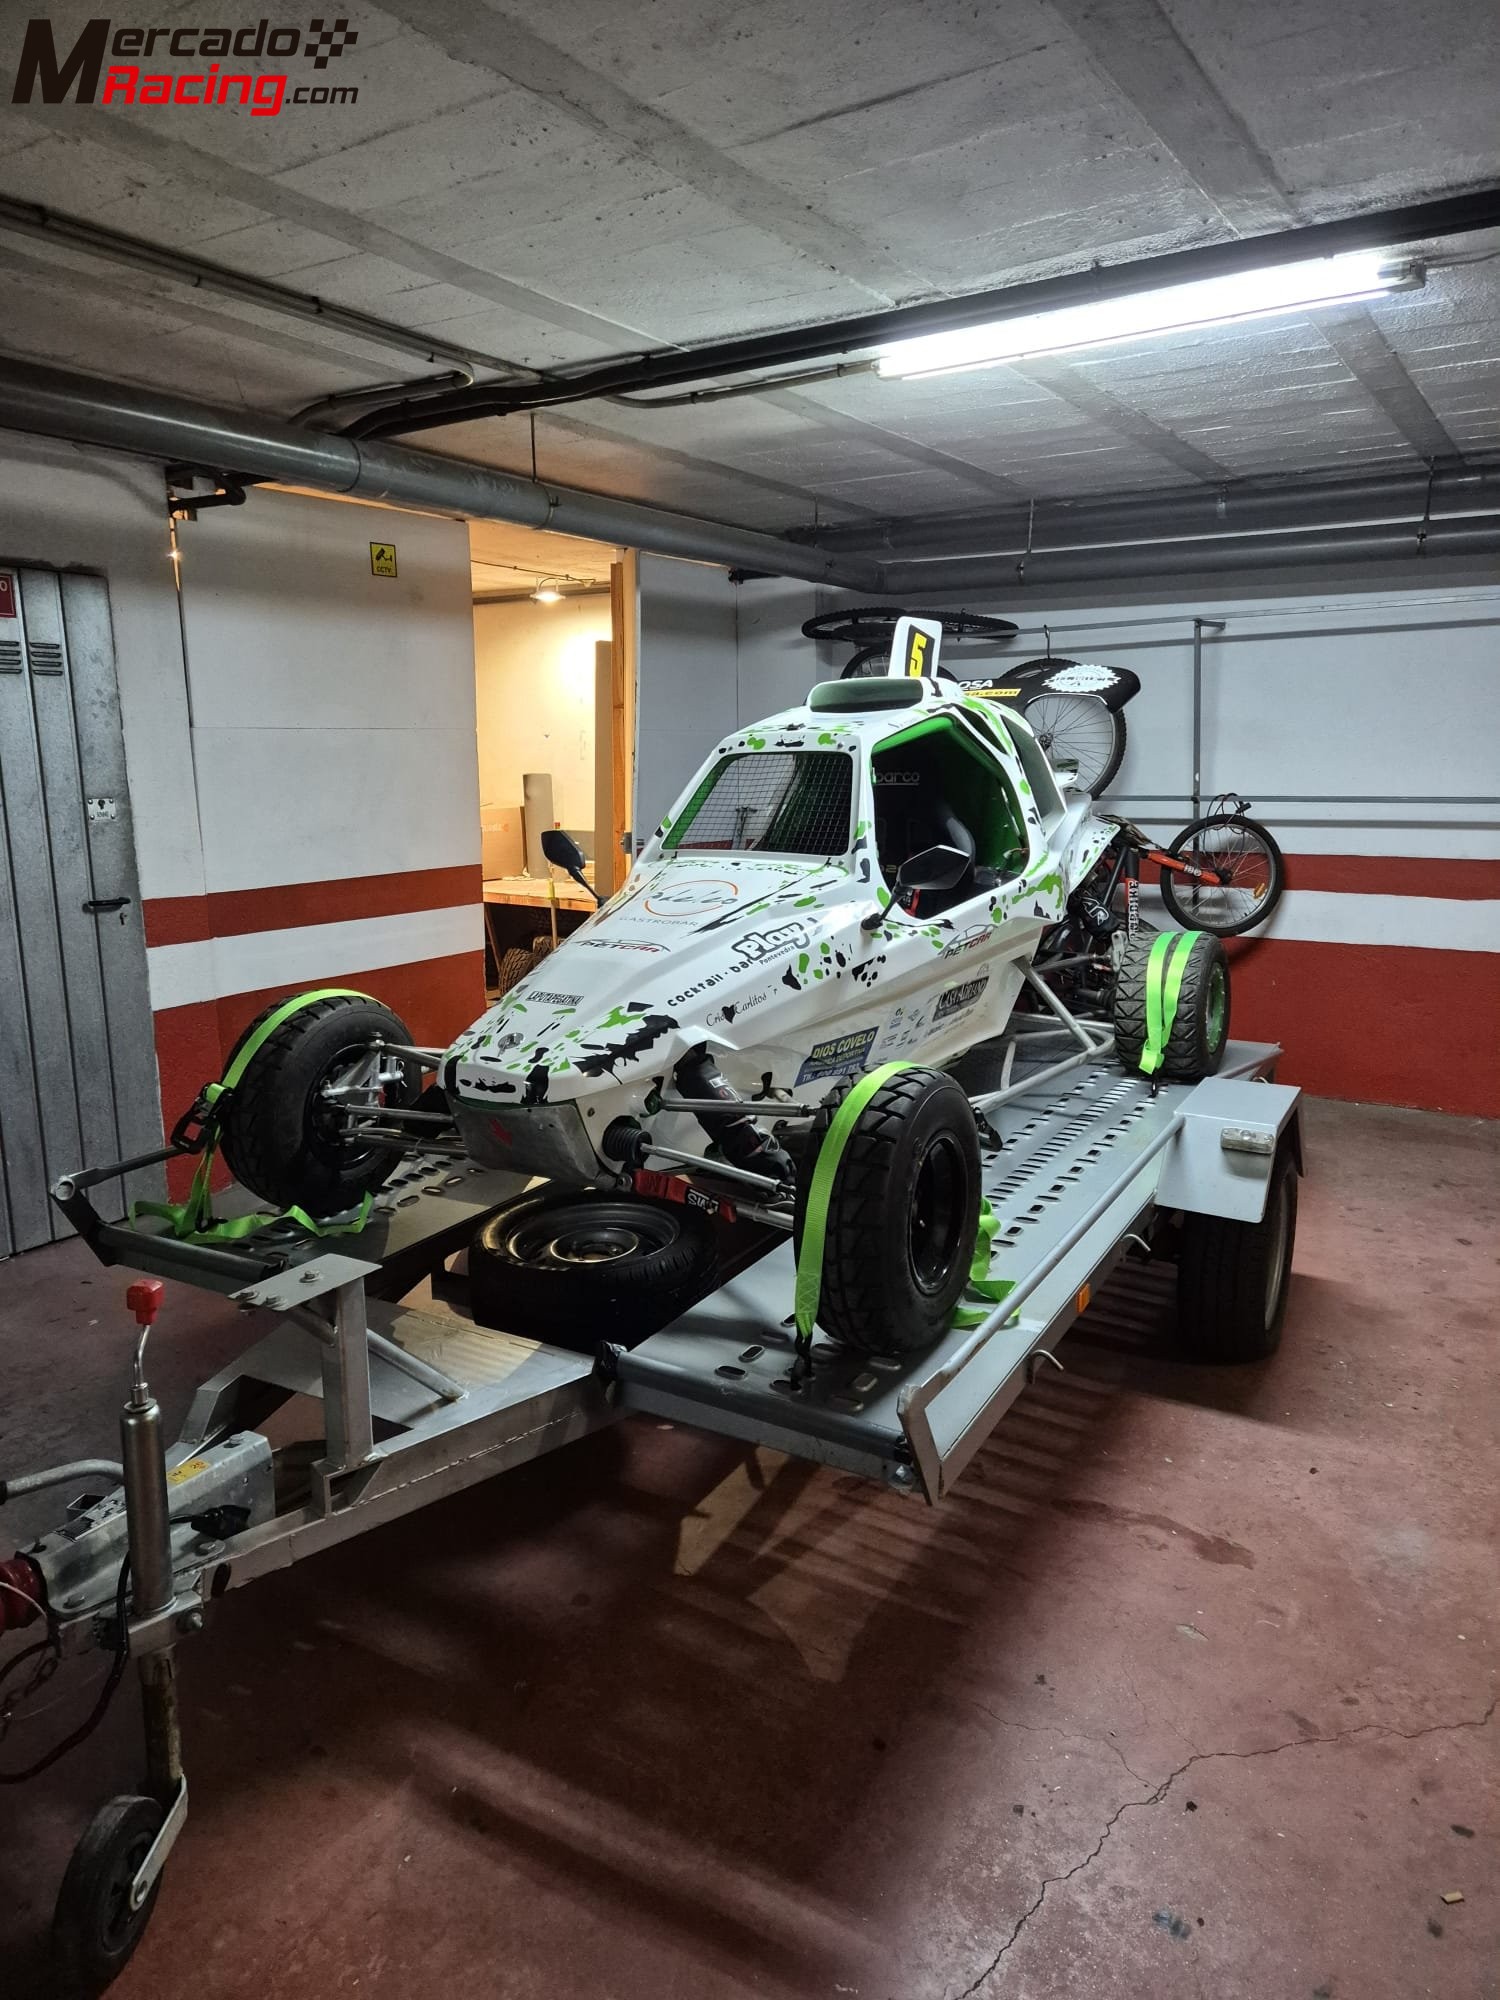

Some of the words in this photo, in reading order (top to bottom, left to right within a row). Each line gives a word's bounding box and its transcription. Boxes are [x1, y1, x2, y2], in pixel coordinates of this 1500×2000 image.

[909, 632, 928, 678] 5
[958, 679, 993, 690] OSA
[876, 771, 921, 782] parco
[731, 922, 811, 961] Play
[759, 944, 795, 966] Pontevedra
[944, 931, 992, 960] PETCAR
[667, 973, 724, 1007] cocktail
[730, 958, 755, 974] bar
[735, 991, 768, 1014] Carlitos
[812, 1042, 835, 1059] DIOS
[836, 1029, 875, 1054] COVELO
